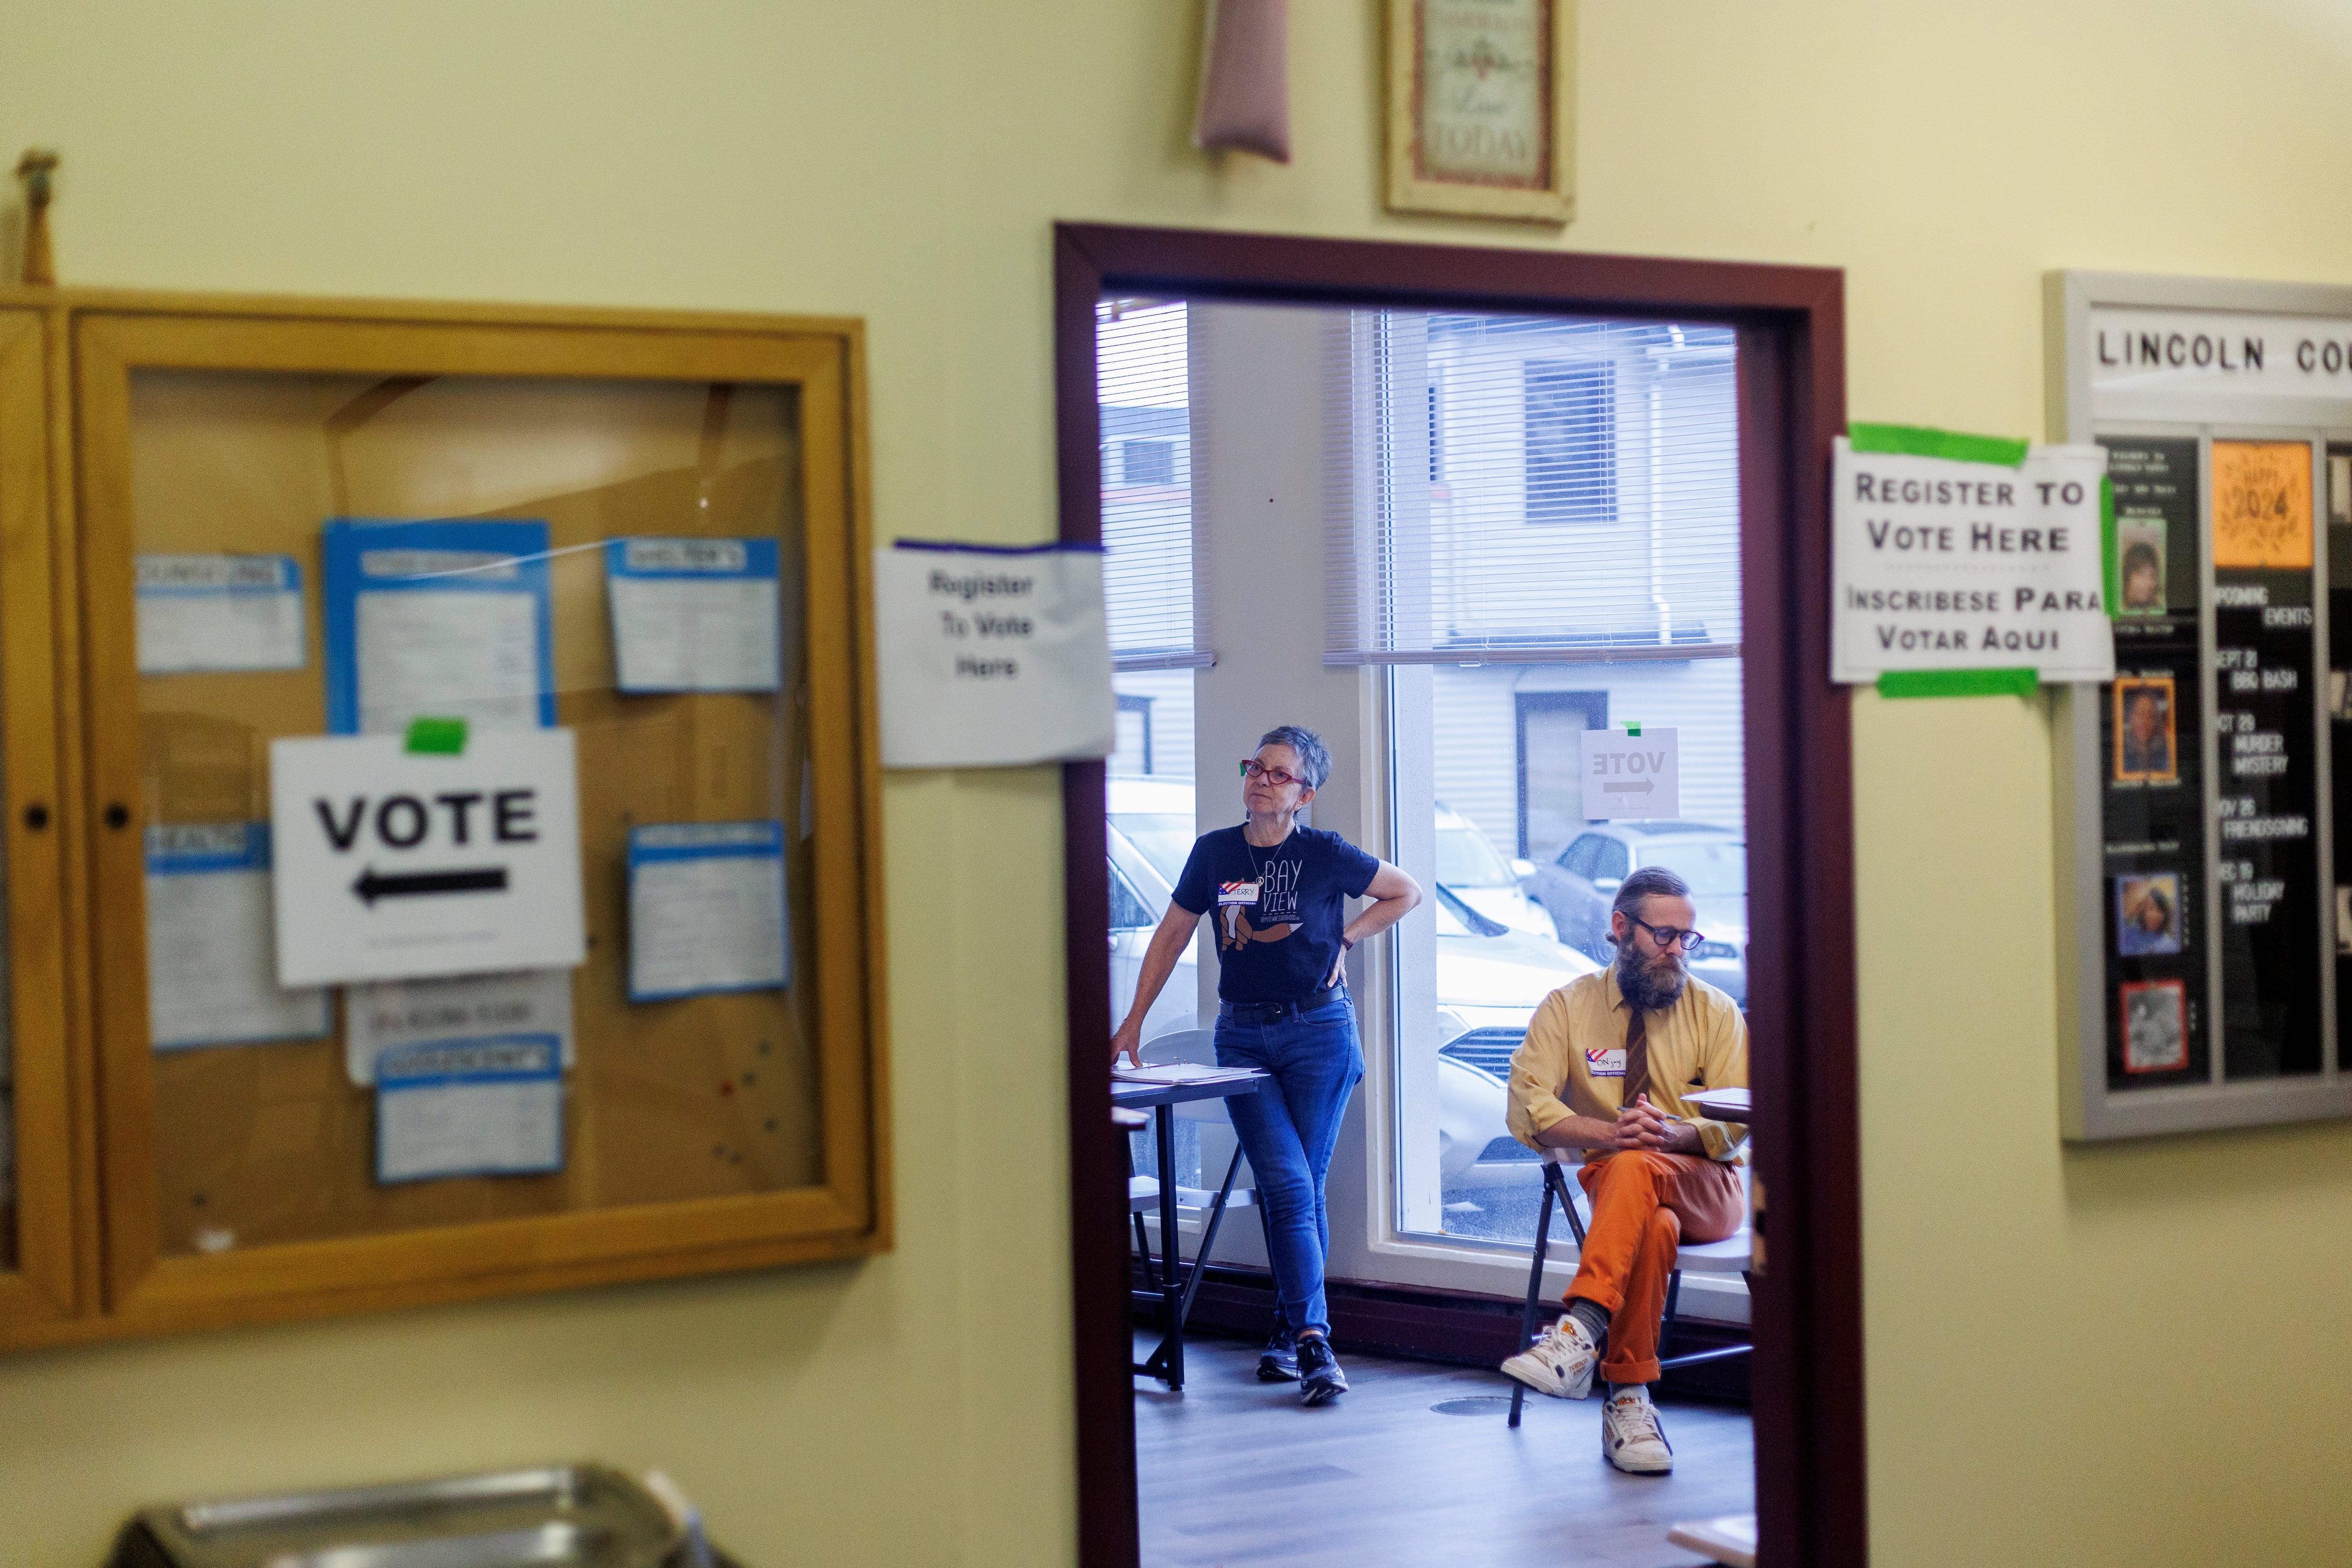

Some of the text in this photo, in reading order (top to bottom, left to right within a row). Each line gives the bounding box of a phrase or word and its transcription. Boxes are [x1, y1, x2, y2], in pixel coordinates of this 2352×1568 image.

[2098, 331, 2352, 374] LINCOLN CO
[1855, 472, 2084, 507] REGISTER TO
[1867, 520, 2069, 552] VOTE HERE
[928, 569, 1035, 603] Register
[1846, 584, 2101, 612] INSCRIBESE PARA
[940, 610, 1034, 639] To Vote
[2264, 607, 2312, 626] EVENTS
[1877, 625, 2059, 651] VOTAR AQUI
[954, 653, 1019, 679] Here
[2233, 669, 2298, 690] BBQ BASH
[2234, 733, 2284, 752] MURDER
[2234, 755, 2289, 774] MYSTERY
[314, 788, 540, 853] VOTE
[1264, 860, 1303, 893] BAY
[1263, 891, 1298, 912] VIEW
[2233, 882, 2285, 901] HOLIDAY
[2234, 904, 2272, 922] PARTY
